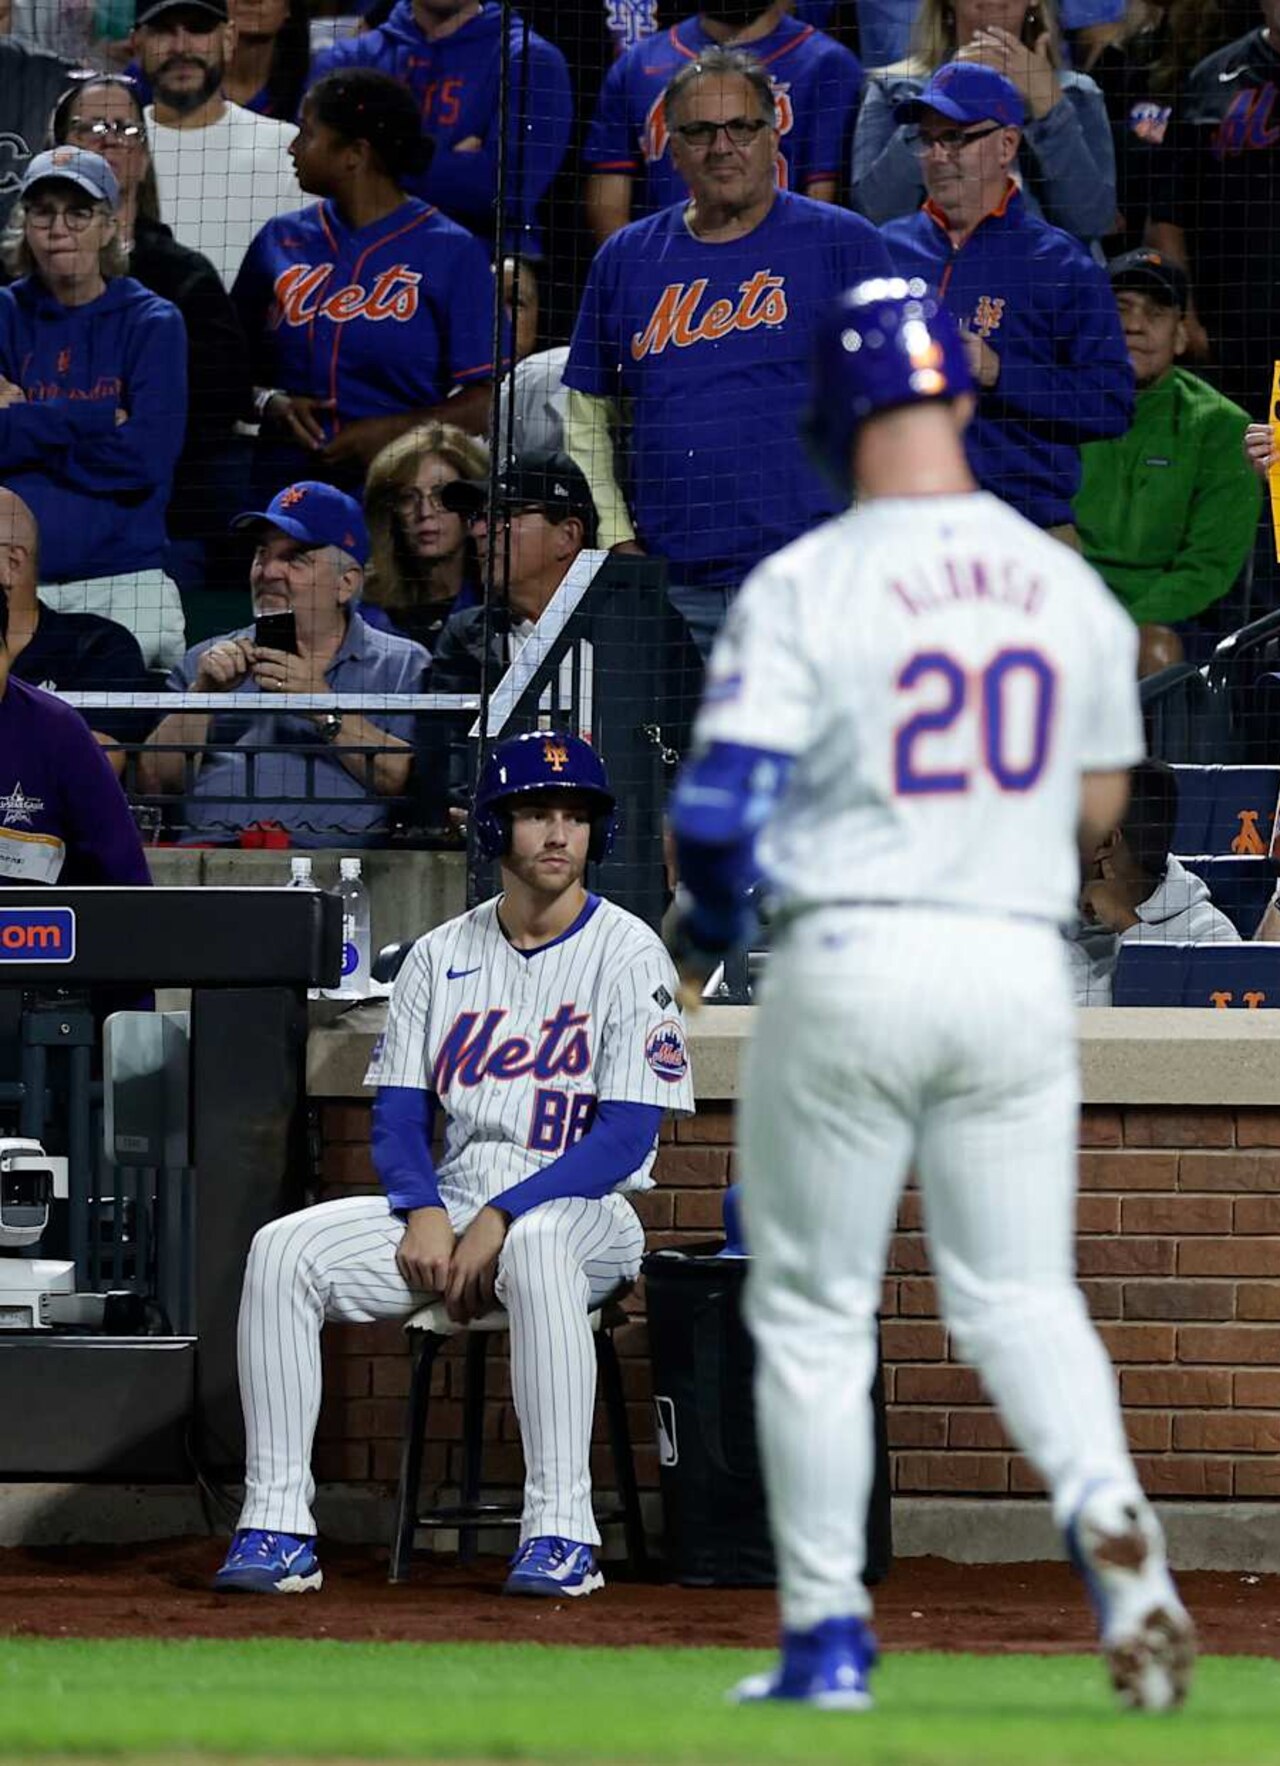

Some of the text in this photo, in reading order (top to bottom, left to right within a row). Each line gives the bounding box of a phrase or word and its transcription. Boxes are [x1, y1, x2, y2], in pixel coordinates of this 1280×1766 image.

[272, 263, 423, 327] Mets
[630, 268, 788, 361] Mets
[892, 645, 1060, 796] 20
[434, 1001, 593, 1096] Mets
